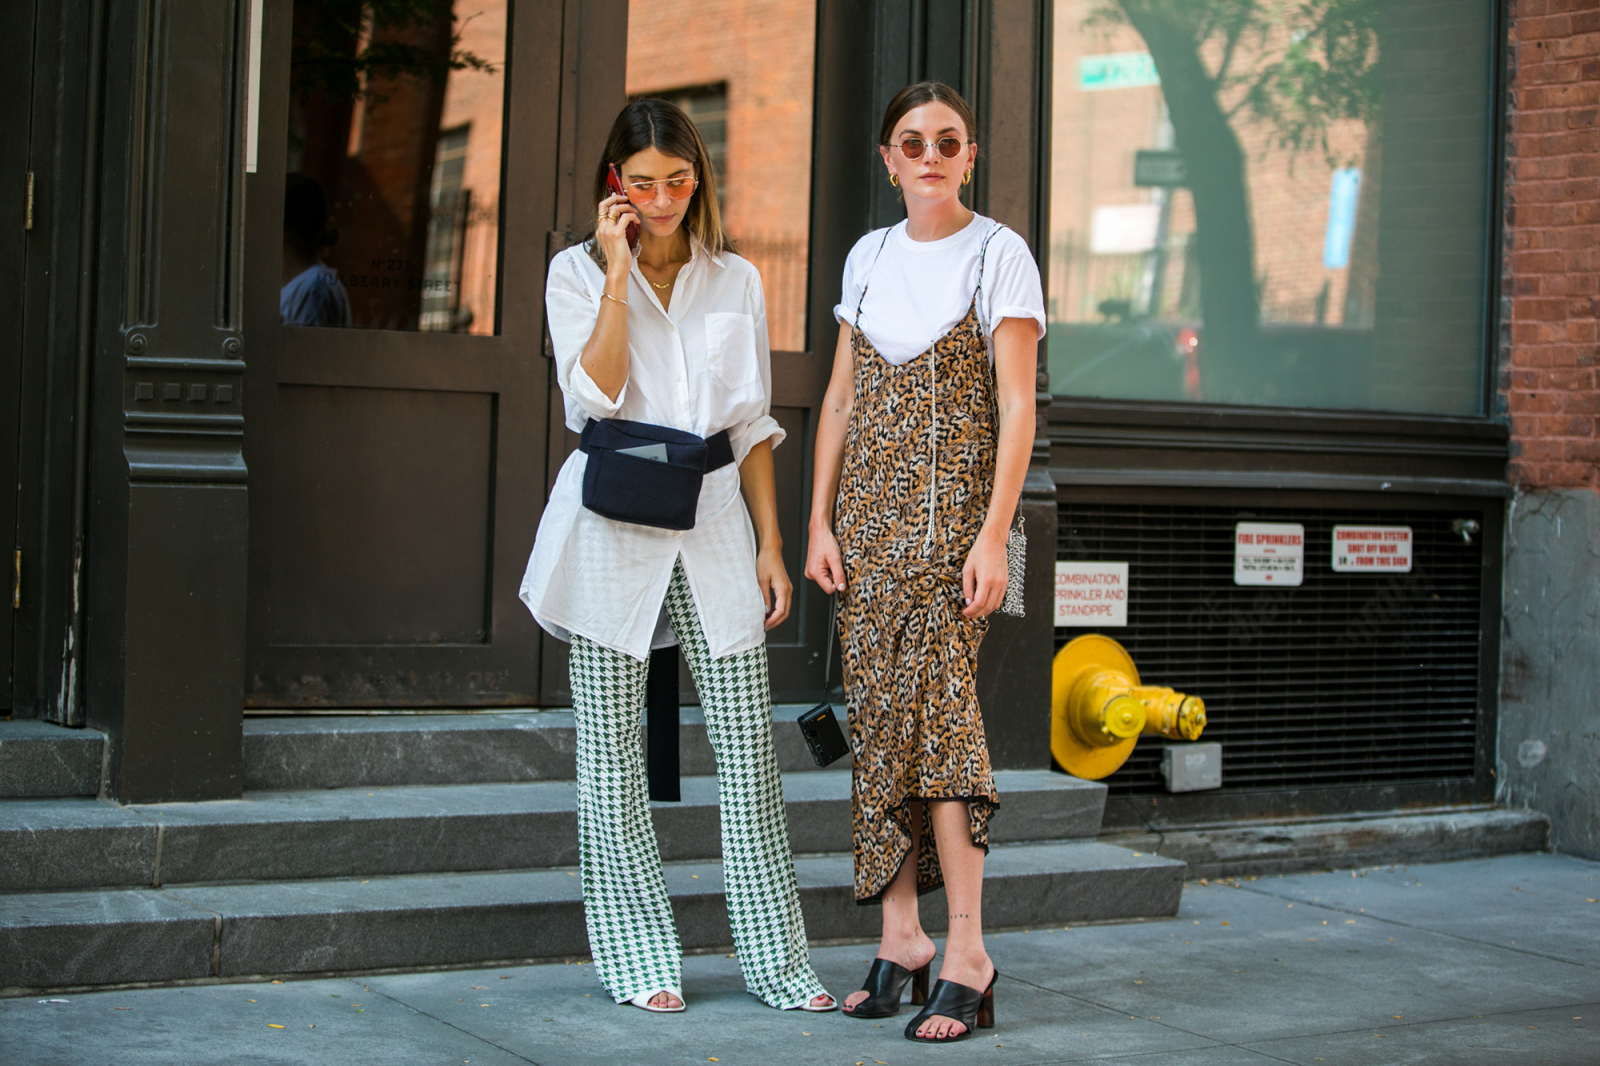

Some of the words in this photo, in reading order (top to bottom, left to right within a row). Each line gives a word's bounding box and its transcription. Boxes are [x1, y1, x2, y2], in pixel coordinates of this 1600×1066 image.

[317, 273, 401, 288] MULBERRY
[407, 276, 461, 292] STREET
[1238, 533, 1254, 545] FIRE
[1256, 533, 1302, 546] SPRINKLERS
[1336, 530, 1382, 541] COMBINATION
[1383, 531, 1409, 542] SYSTEM
[1347, 544, 1365, 554] SHUT
[1366, 544, 1377, 554] OFF
[1379, 544, 1398, 554] VALVE
[1355, 556, 1374, 566] FROM
[1376, 556, 1391, 566] THIS
[1392, 556, 1408, 567] SIGN
[1054, 589, 1103, 601] PRINKLER
[1104, 589, 1126, 601] AND
[1059, 604, 1113, 617] STANDPIPE
